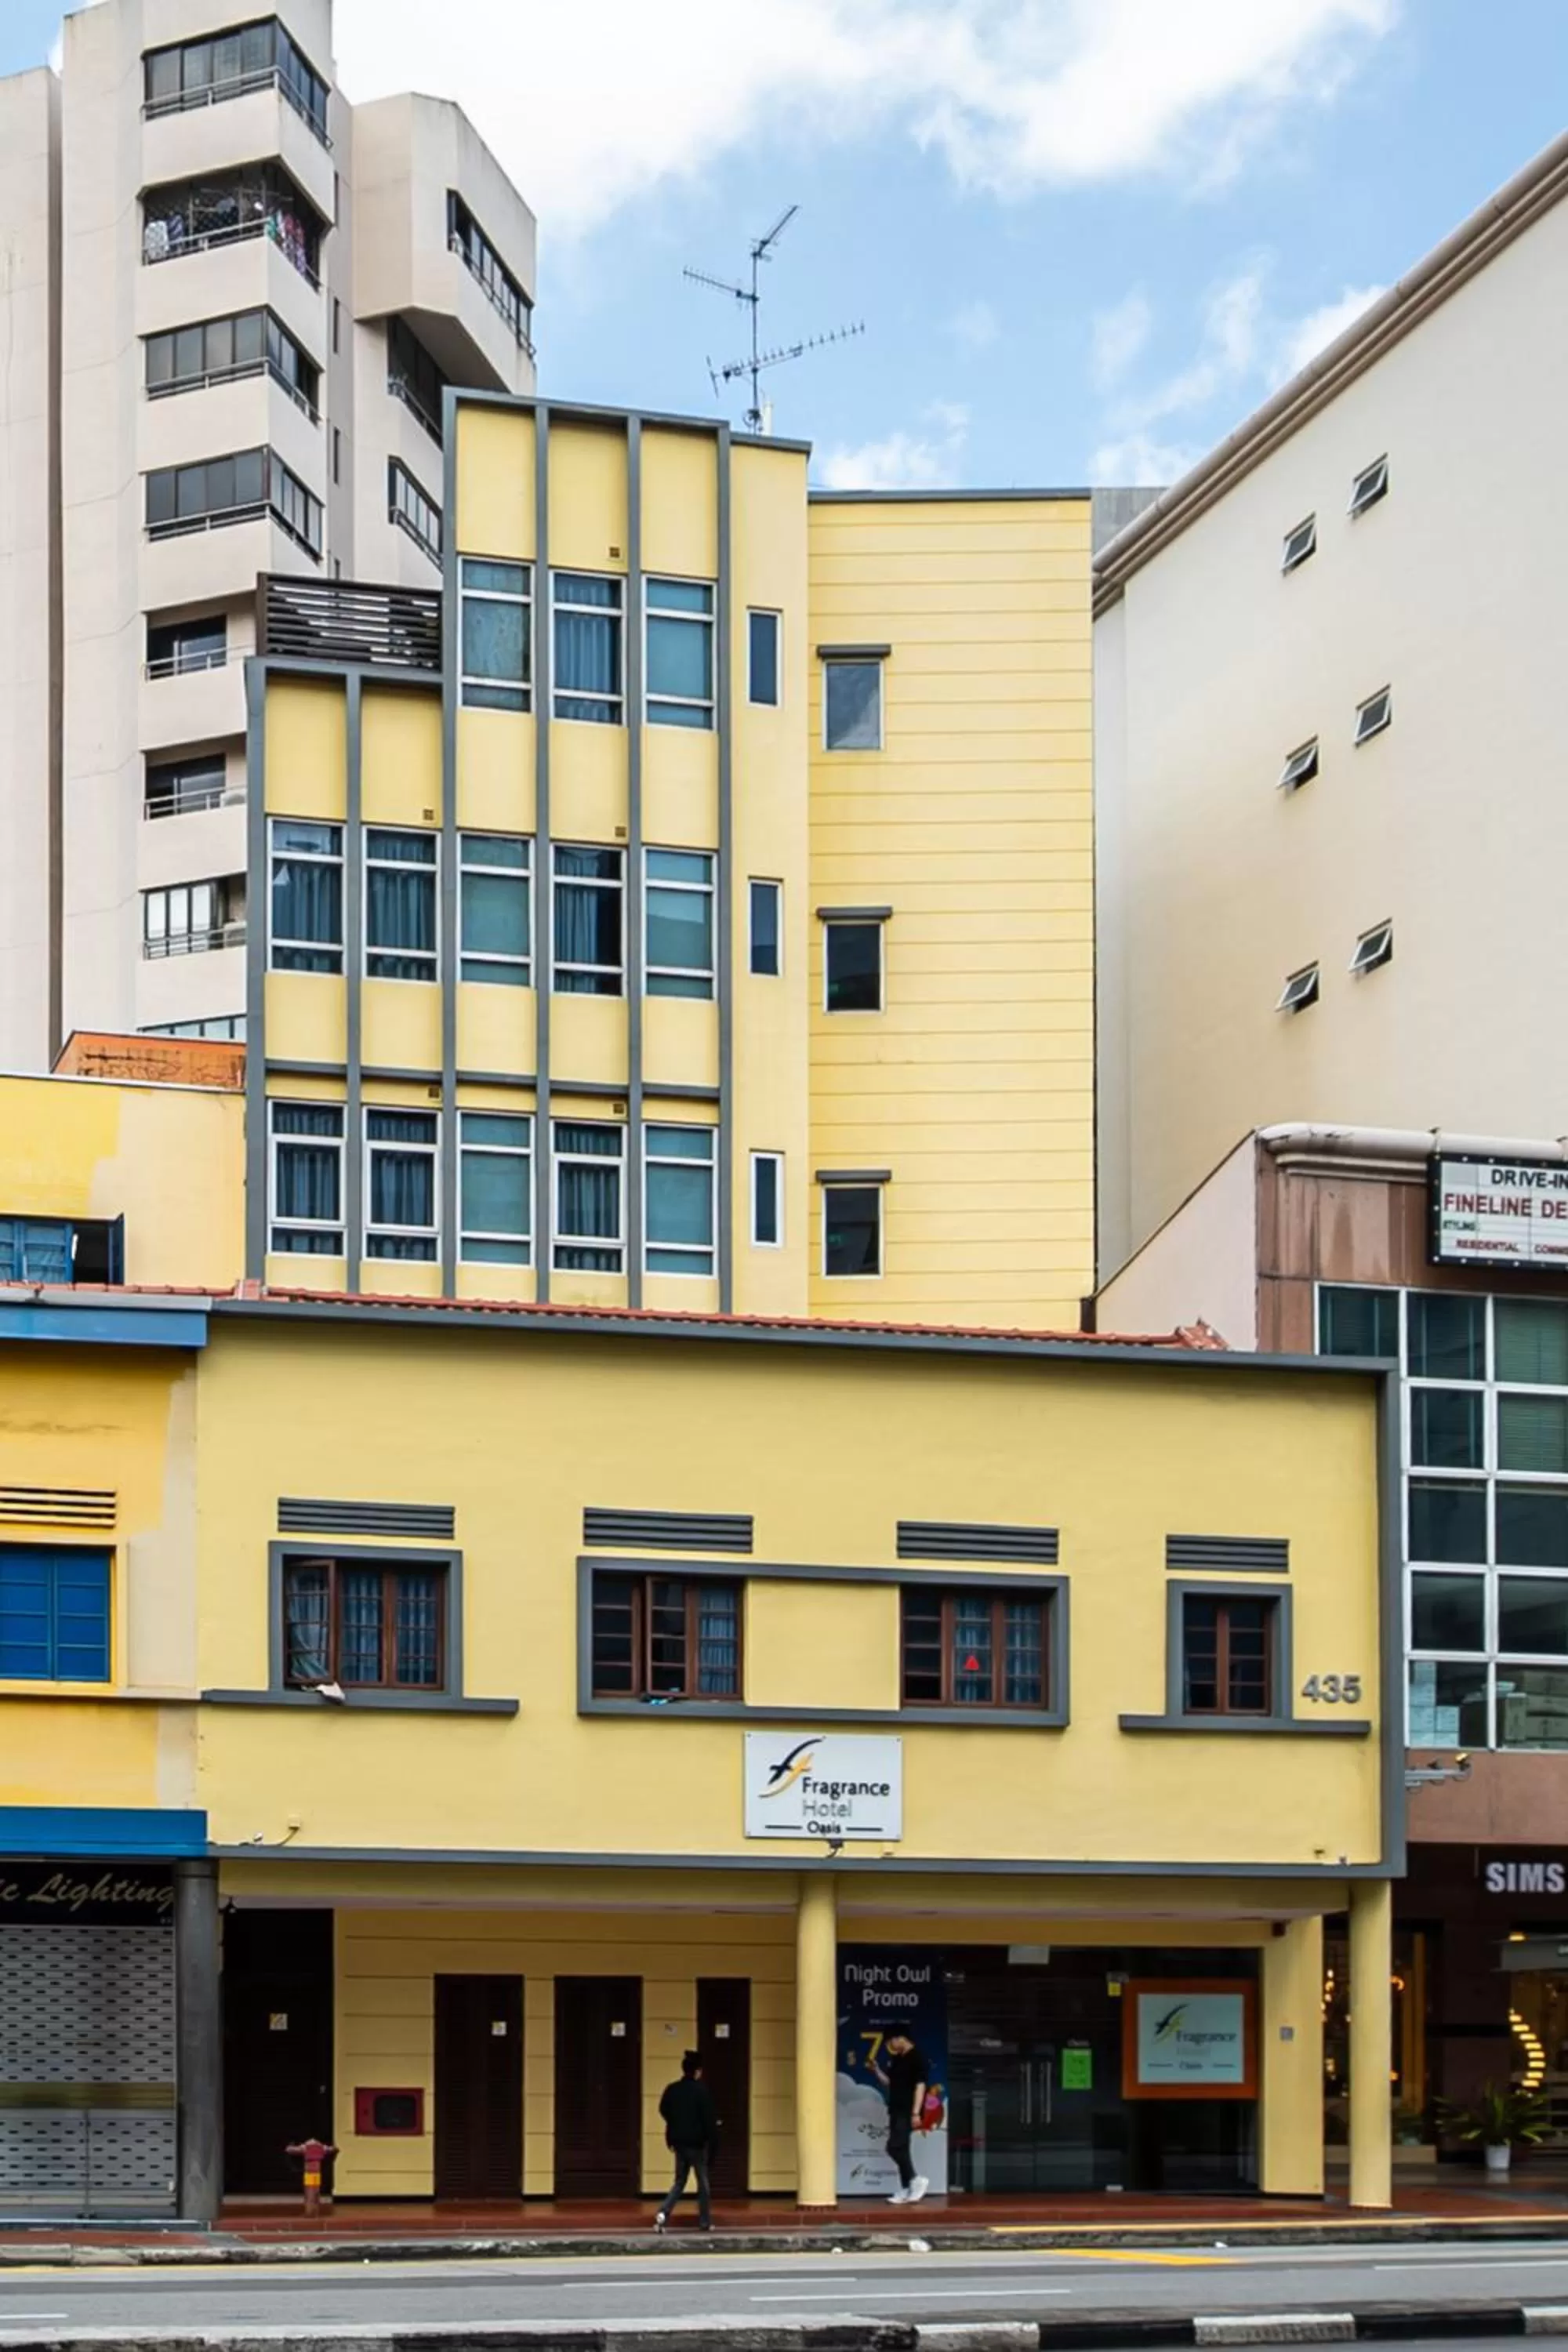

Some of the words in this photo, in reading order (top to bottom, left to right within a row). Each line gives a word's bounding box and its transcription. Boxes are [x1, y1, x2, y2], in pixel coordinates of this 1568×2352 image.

[1491, 1169, 1568, 1189] DRIVE-IN
[1443, 1193, 1532, 1217] FINELINE
[1301, 1674, 1361, 1704] 435
[802, 1777, 890, 1800] Fragrance
[802, 1799, 852, 1817] Hotel
[807, 1820, 841, 1835] Oasis
[1486, 1862, 1565, 1893] SIMS
[26, 1873, 175, 1913] Lighting
[844, 1964, 891, 1986] Night
[897, 1964, 931, 1982] Owl
[863, 1989, 919, 2006] Promo
